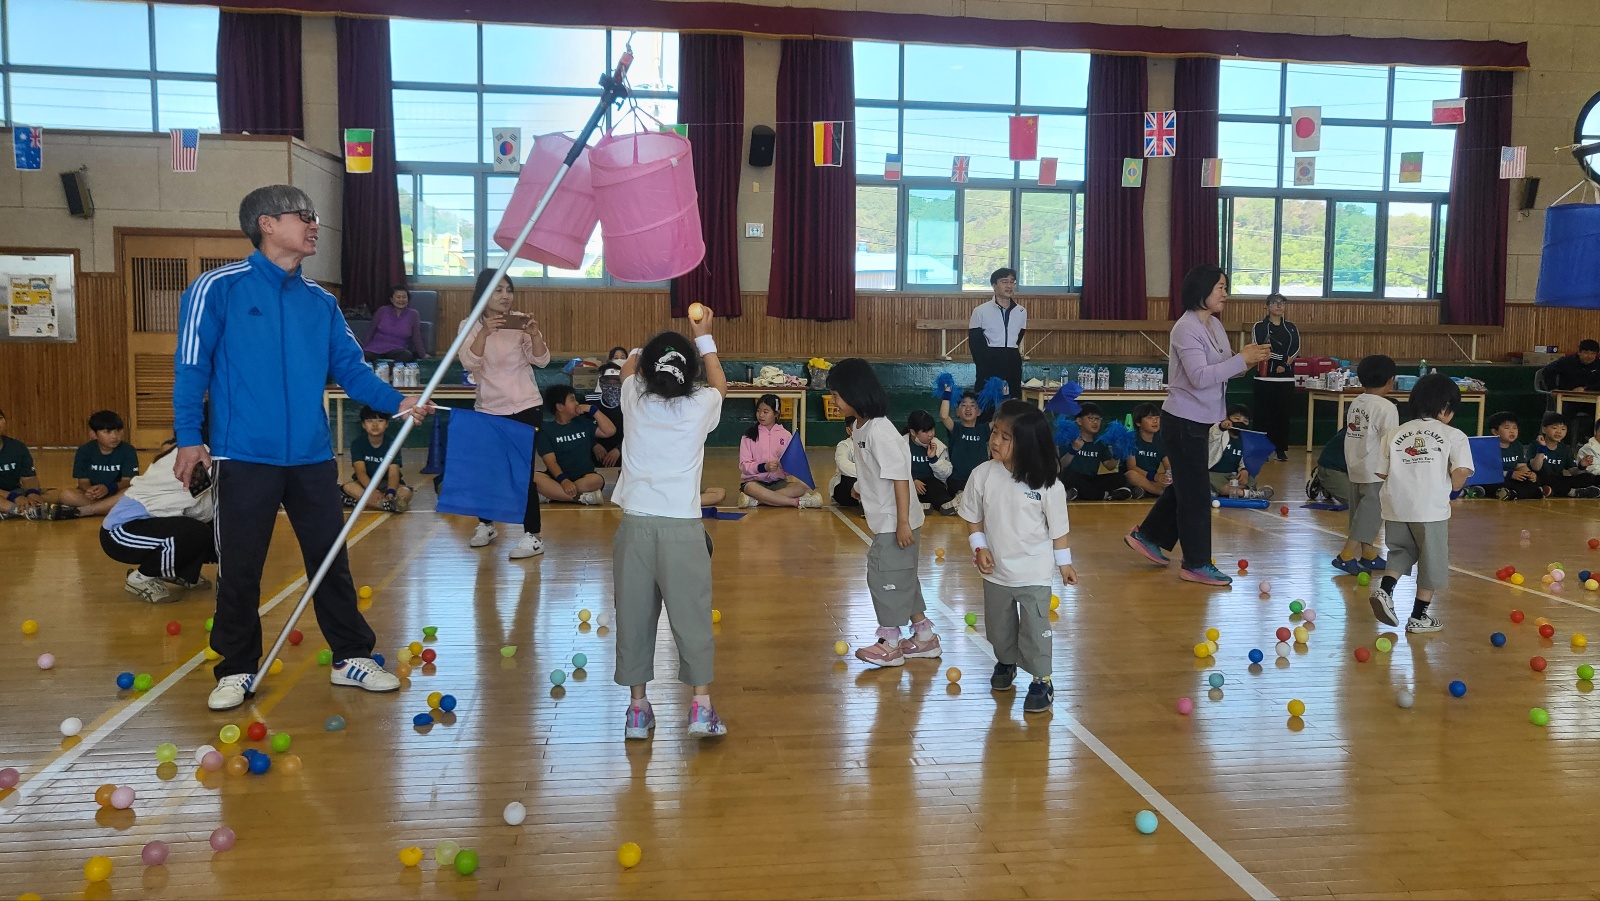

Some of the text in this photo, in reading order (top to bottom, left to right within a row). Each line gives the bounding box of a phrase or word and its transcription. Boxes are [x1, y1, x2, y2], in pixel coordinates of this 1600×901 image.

[556, 432, 586, 443] MILLET
[1395, 431, 1414, 445] HIKE
[91, 464, 121, 472] MILLET
